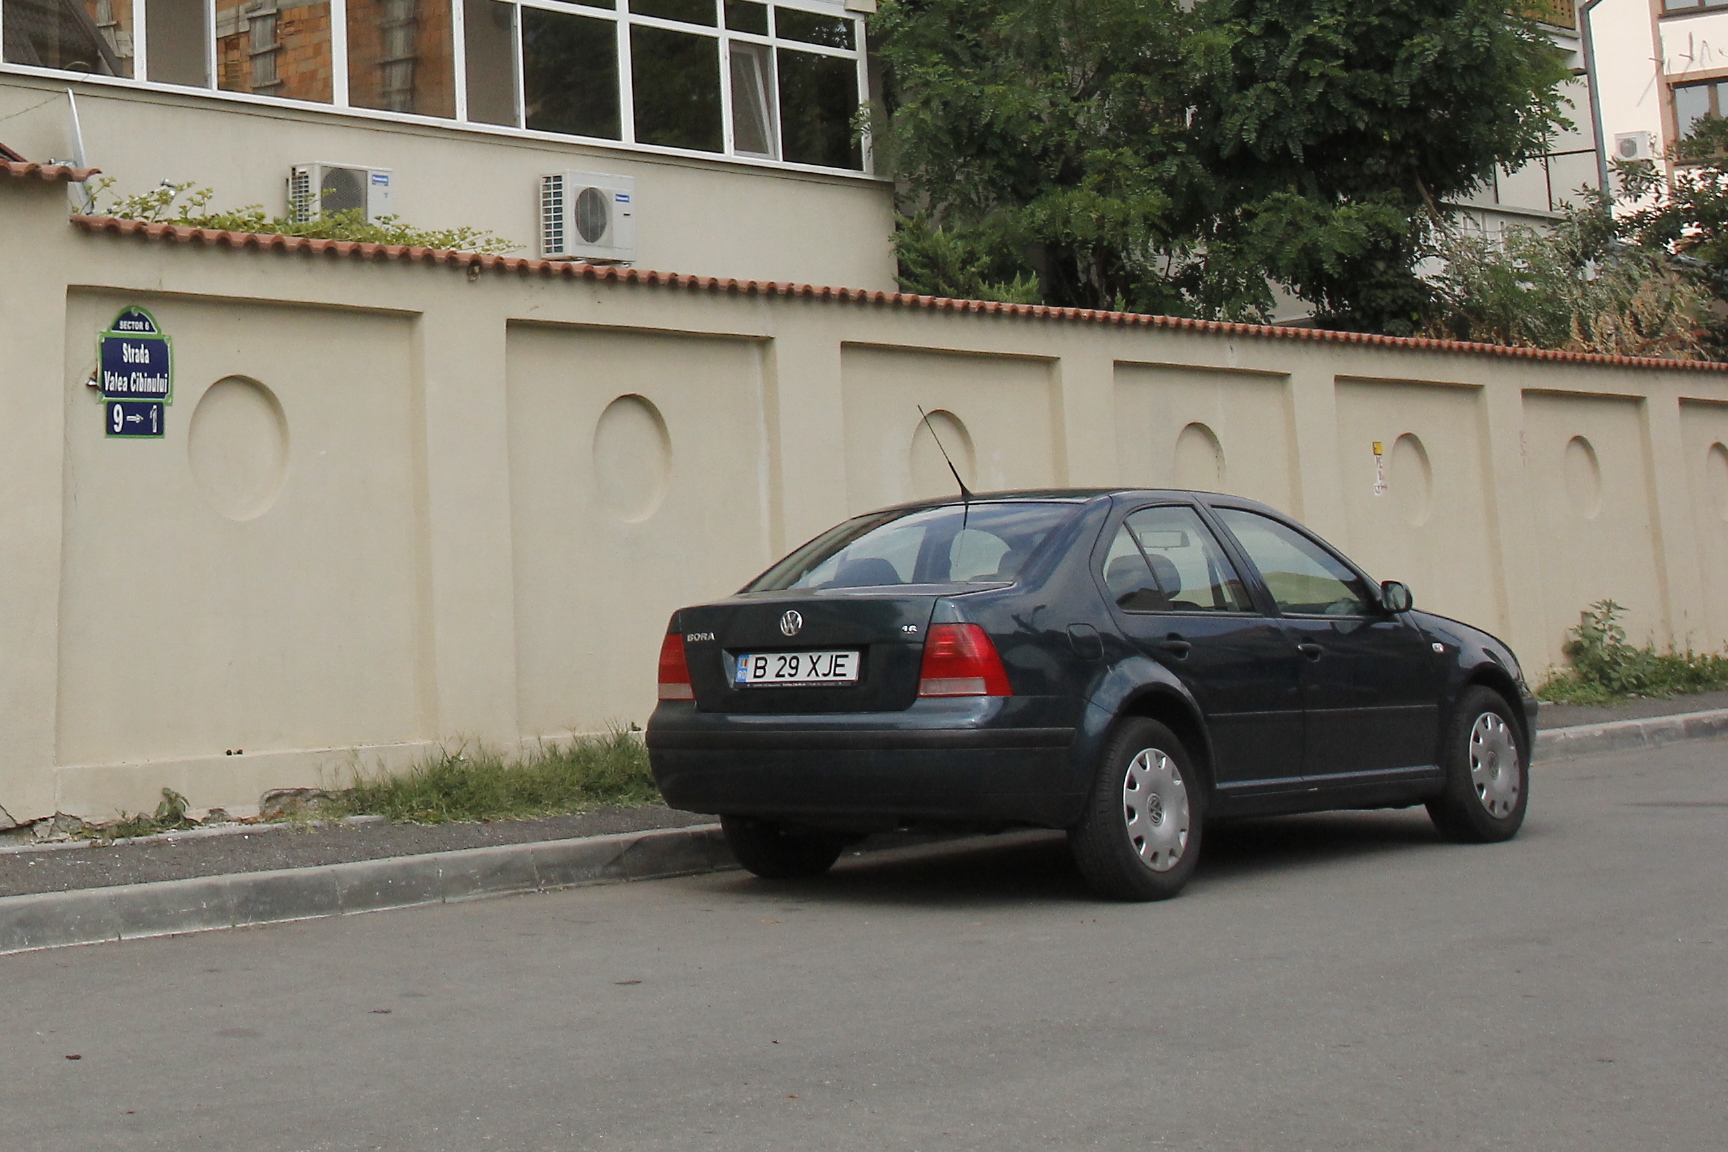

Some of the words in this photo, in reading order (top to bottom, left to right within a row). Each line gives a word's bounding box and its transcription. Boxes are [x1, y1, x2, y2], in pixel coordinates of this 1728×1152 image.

[119, 320, 144, 330] SECTOR
[144, 321, 150, 331] 6
[122, 342, 150, 364] Strada
[104, 370, 128, 392] Valea
[130, 371, 168, 393] Cibinului
[113, 403, 124, 433] 9
[149, 404, 158, 433] 1
[687, 631, 715, 642] BORA
[753, 656, 768, 679] B
[775, 655, 800, 678] 29
[807, 654, 849, 678] XJE
